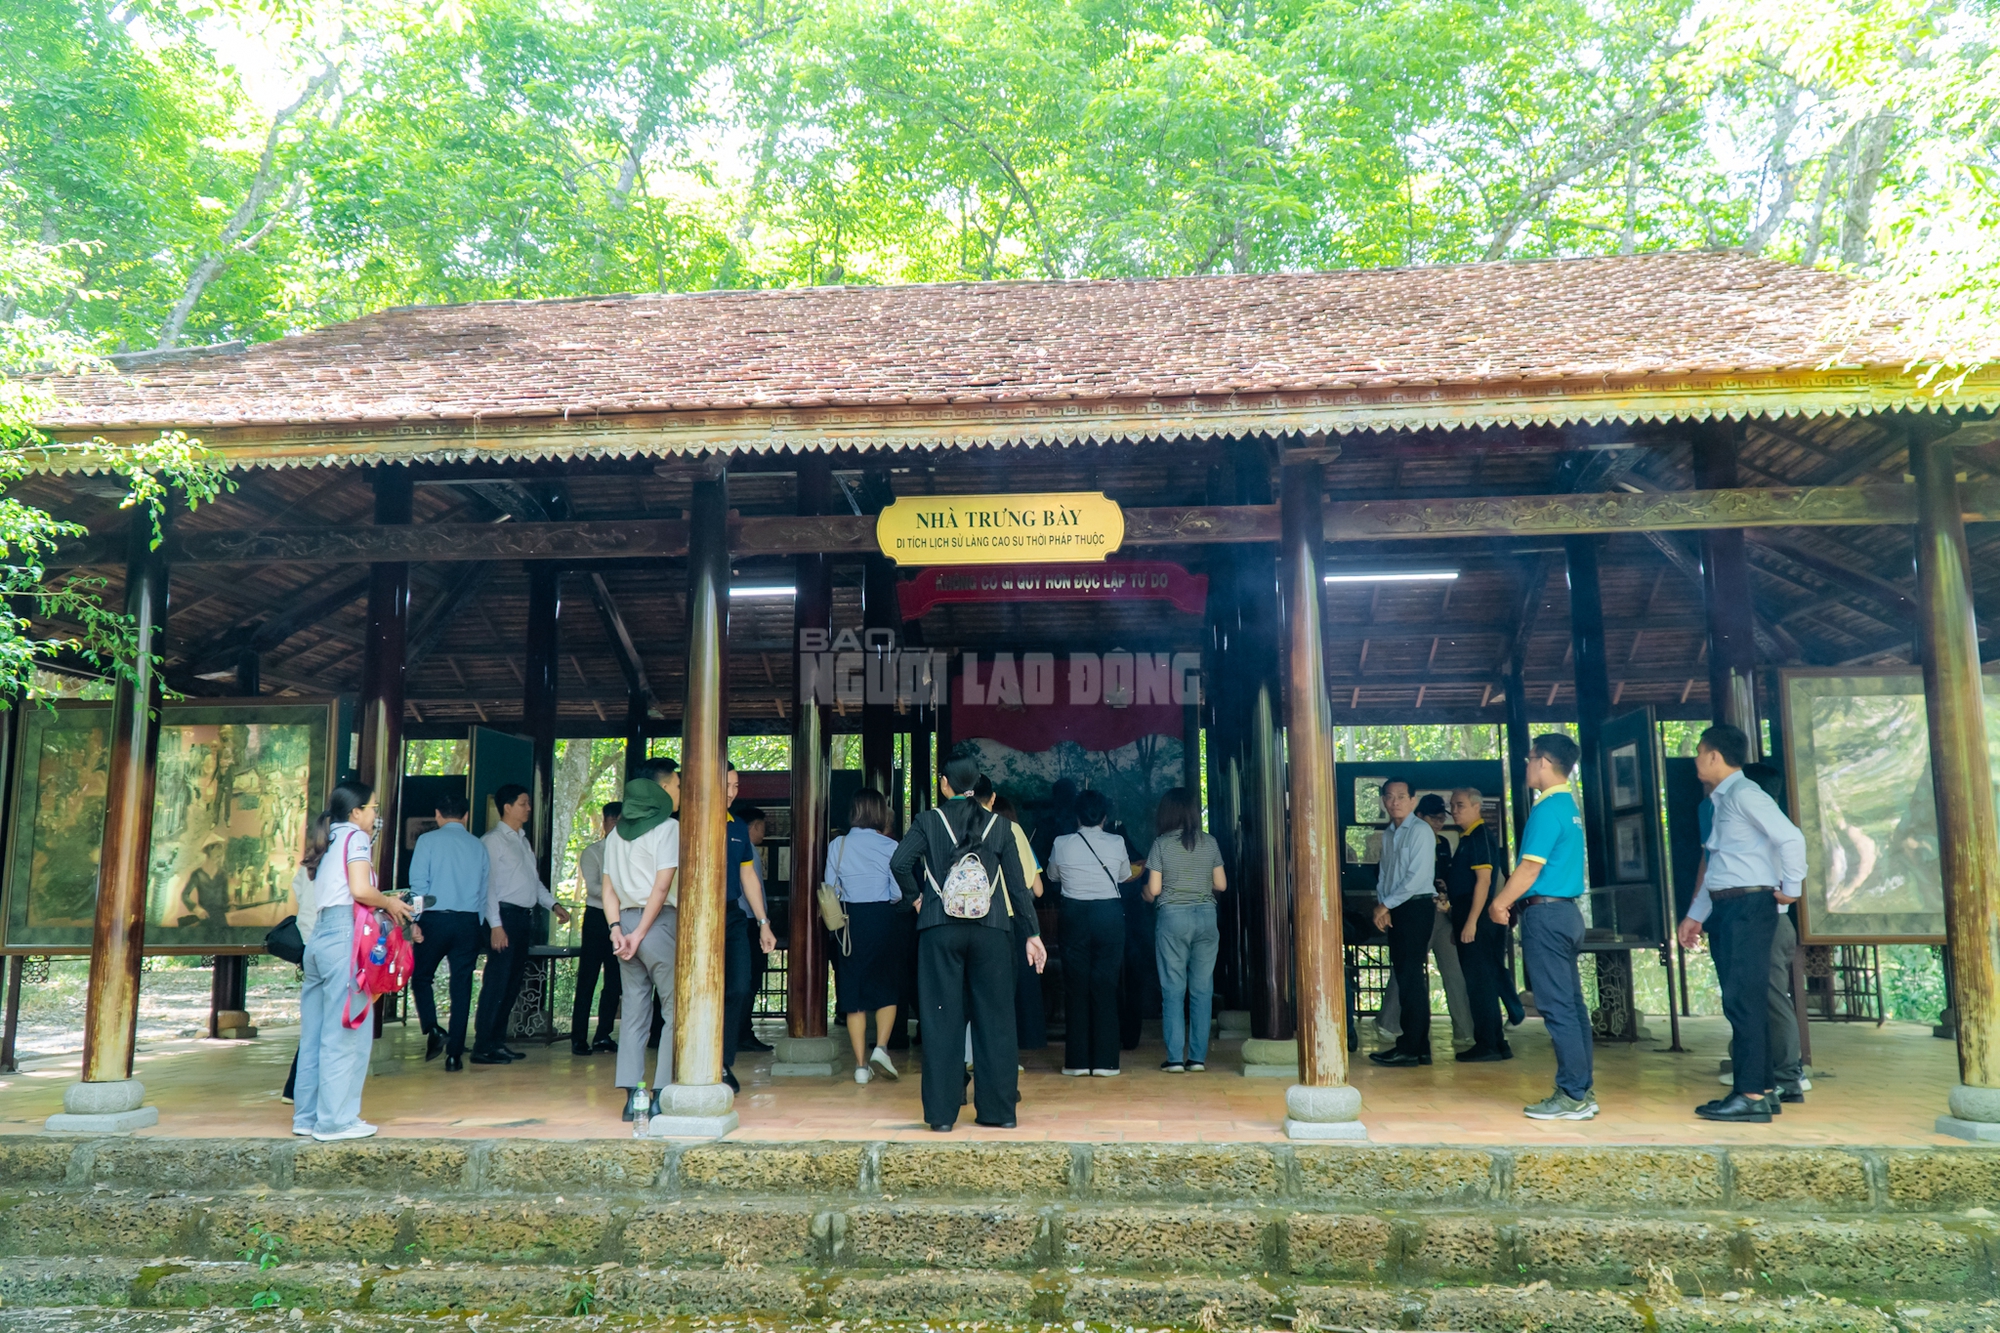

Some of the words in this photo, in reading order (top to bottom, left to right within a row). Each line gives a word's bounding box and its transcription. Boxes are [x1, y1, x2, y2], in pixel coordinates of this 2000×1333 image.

[916, 506, 958, 528] NHÀ
[965, 507, 1036, 528] TRƯNG
[1042, 504, 1082, 526] BÀY
[896, 538, 905, 548] DI
[907, 535, 927, 548] TÍCH
[929, 537, 949, 549] LỊCH
[951, 532, 963, 548] SỬ
[965, 534, 989, 547] LÀNG
[991, 536, 1010, 546] CAO
[1012, 535, 1024, 546] SU
[1026, 531, 1047, 545] THỜI
[1049, 531, 1072, 545] PHÁP
[1075, 531, 1105, 546] THUỘC
[981, 571, 998, 590] CÓ
[1001, 571, 1014, 590] GÌ
[1017, 571, 1042, 590] QUÝ
[1045, 572, 1071, 589] HƠN
[1074, 570, 1100, 593] ĐỘC
[1103, 570, 1126, 593] LẬP
[1151, 573, 1168, 588] DO
